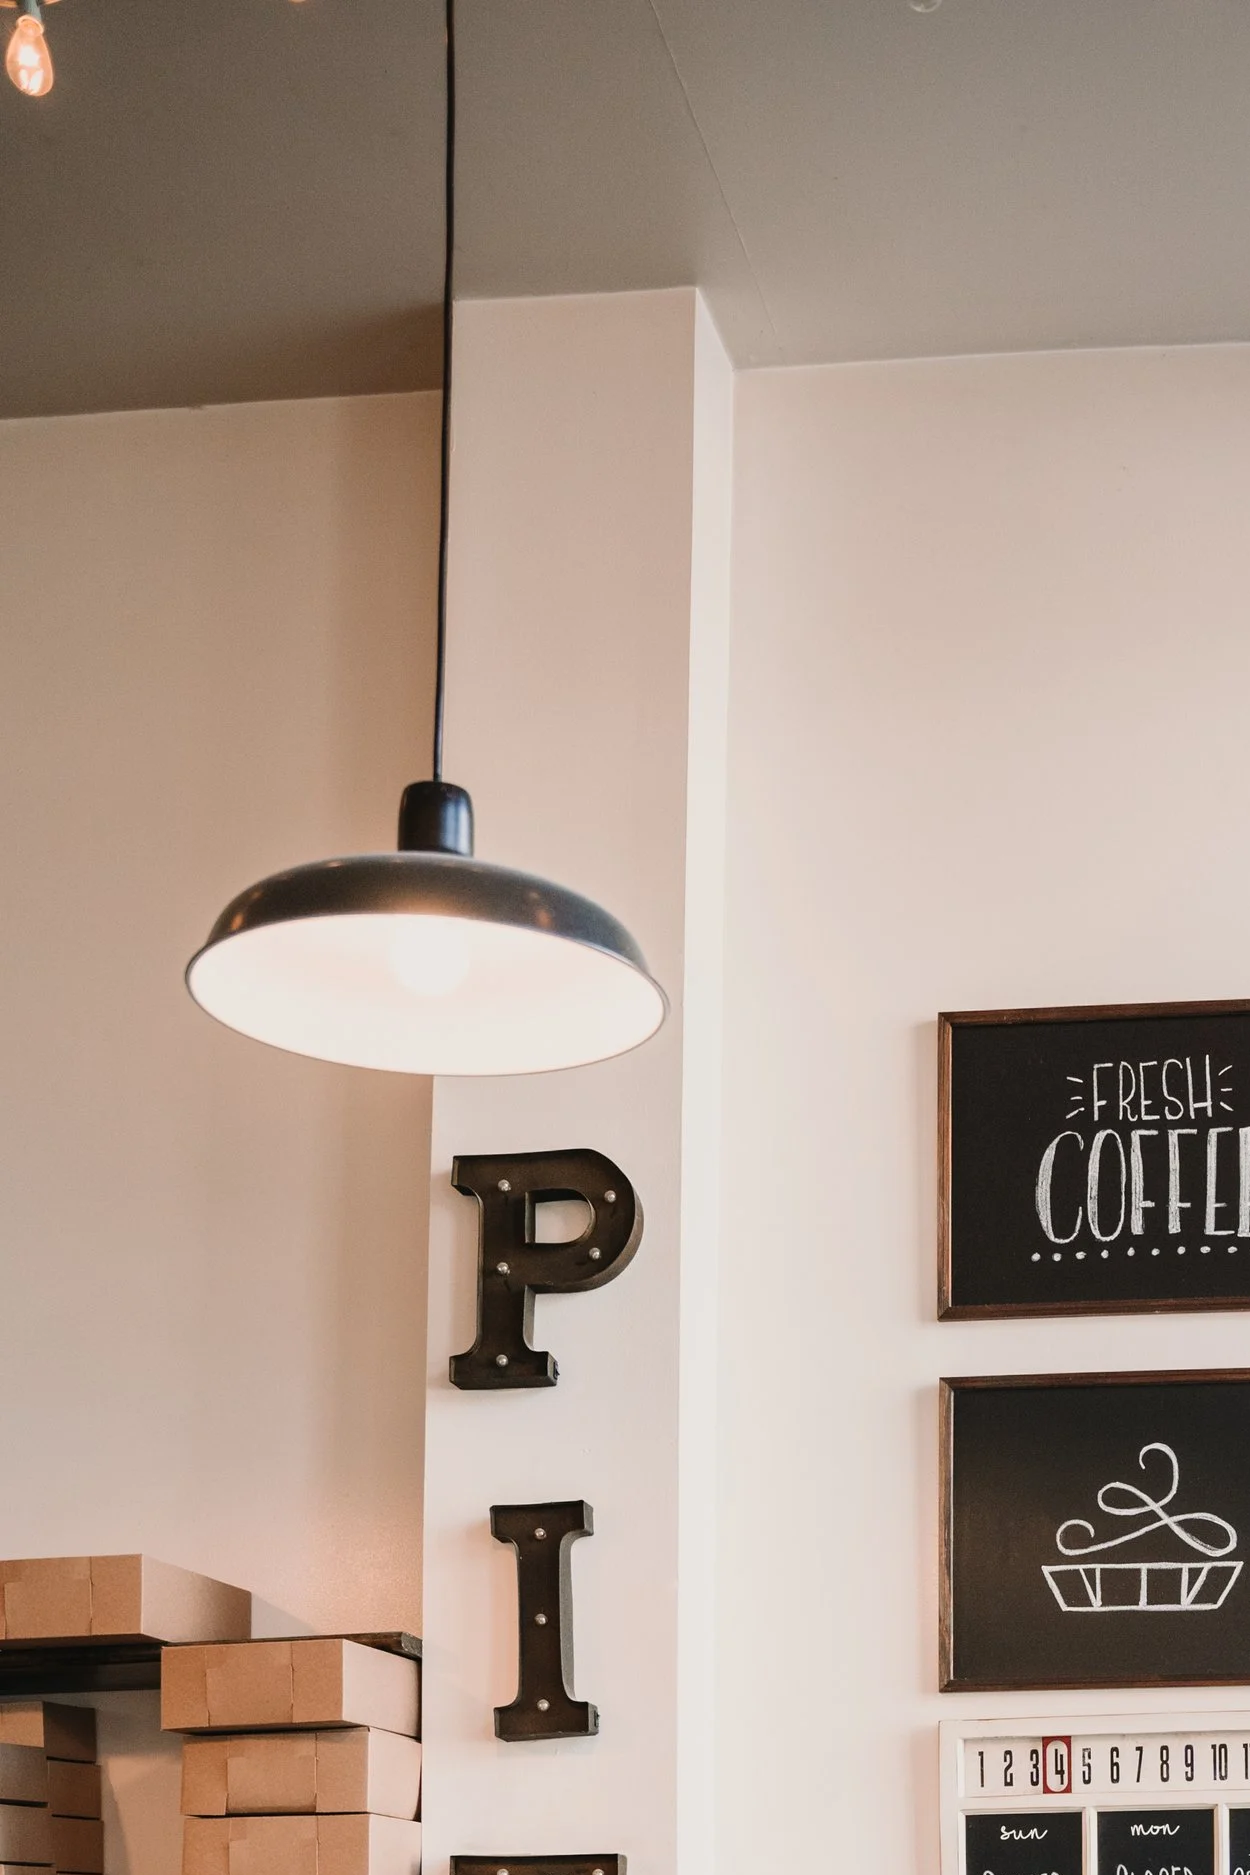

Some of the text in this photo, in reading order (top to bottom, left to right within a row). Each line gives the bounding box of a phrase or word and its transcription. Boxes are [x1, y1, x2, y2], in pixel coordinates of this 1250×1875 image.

[1092, 1053, 1213, 1122] FRESH
[977, 1750, 985, 1788] 1
[1003, 1749, 1014, 1788] 2
[1030, 1748, 1040, 1787] 3
[1053, 1747, 1066, 1786] 4
[1081, 1747, 1092, 1785] 5
[1110, 1746, 1120, 1784] 6
[1135, 1745, 1145, 1784] 7
[1159, 1744, 1170, 1783] 8
[1184, 1744, 1195, 1782] 9
[1210, 1743, 1229, 1782] 10
[1000, 1826, 1048, 1842] sun
[1130, 1822, 1180, 1837] mon
